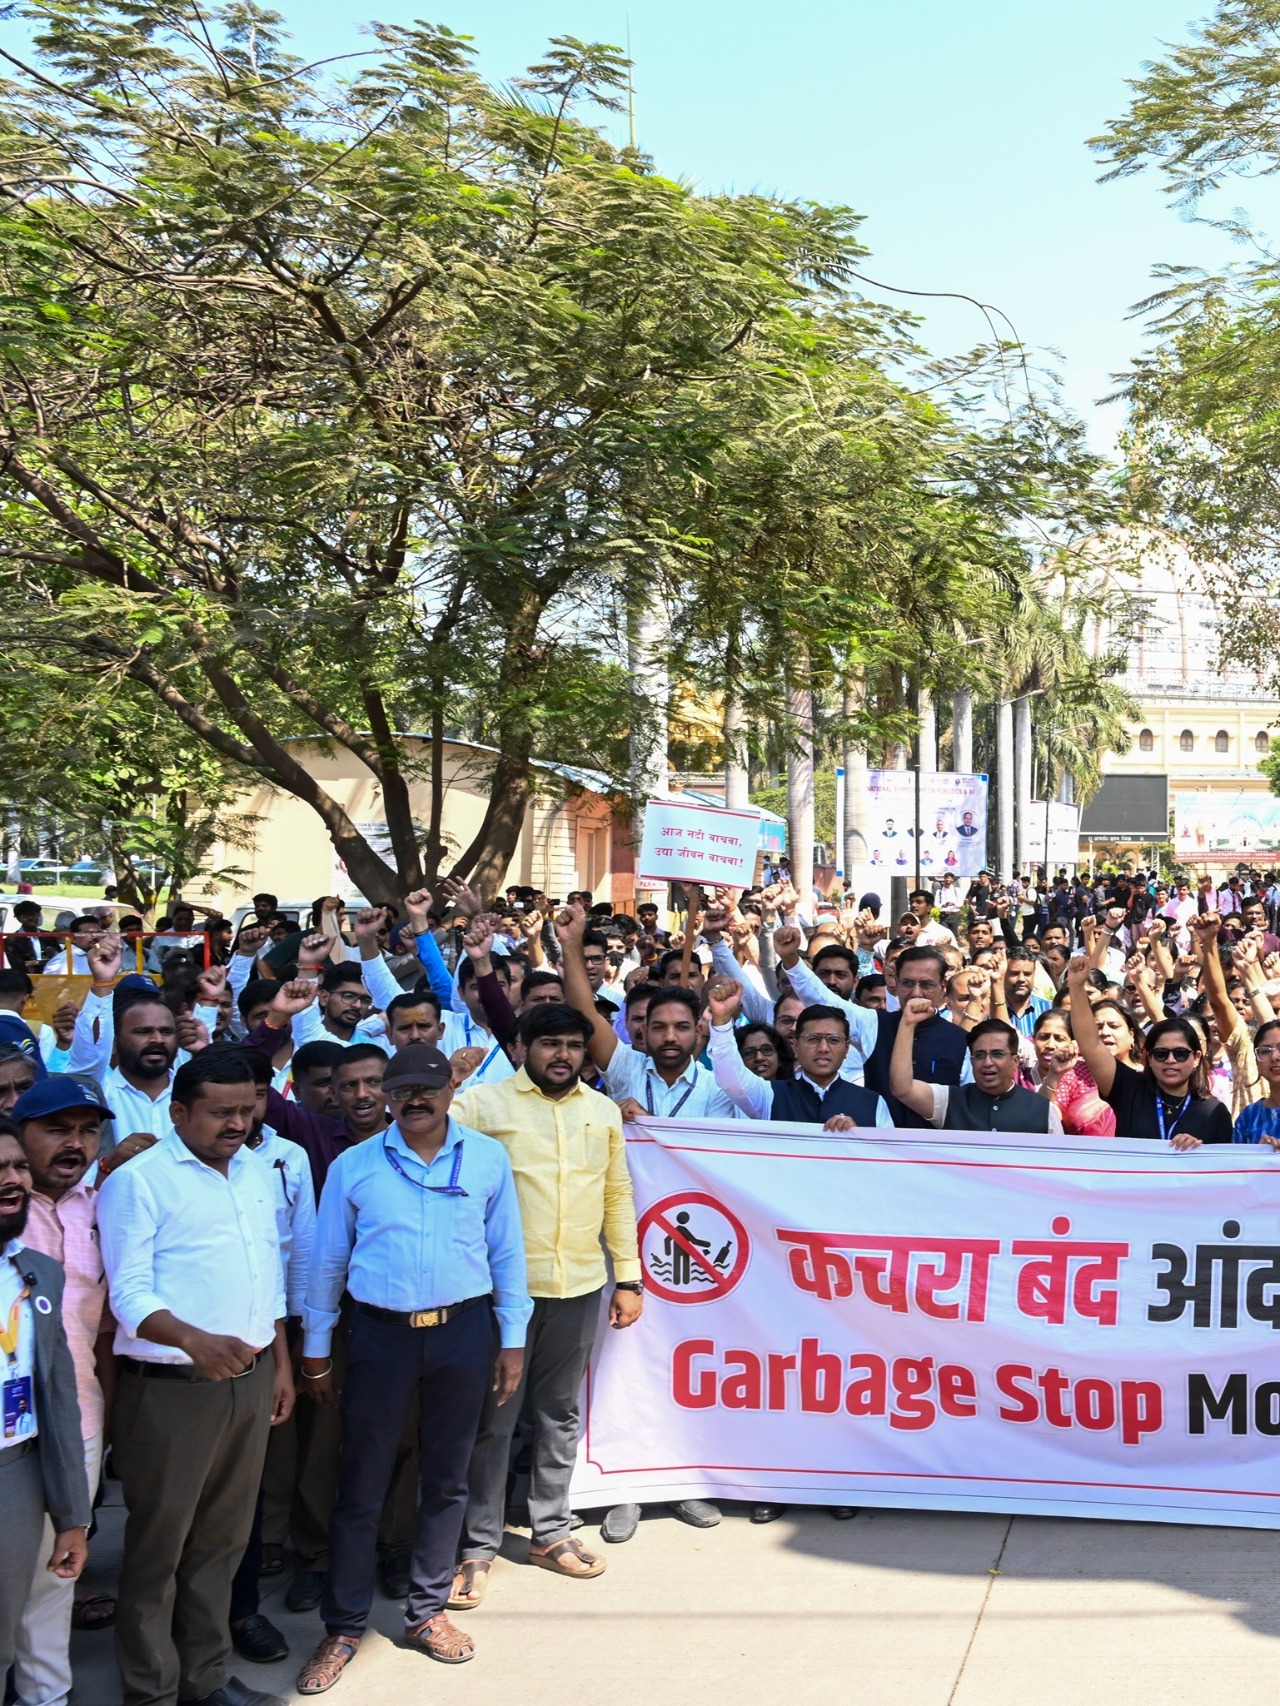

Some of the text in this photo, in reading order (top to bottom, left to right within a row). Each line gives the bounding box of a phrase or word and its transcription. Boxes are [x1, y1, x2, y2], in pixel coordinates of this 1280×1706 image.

[661, 827, 683, 838] आज
[687, 828, 705, 840] नदी
[677, 846, 705, 860] जीवन
[776, 1229, 1000, 1322] कचरा
[1012, 1216, 1129, 1326] बंद
[672, 1338, 977, 1431] Garbage
[995, 1363, 1163, 1445] Stop
